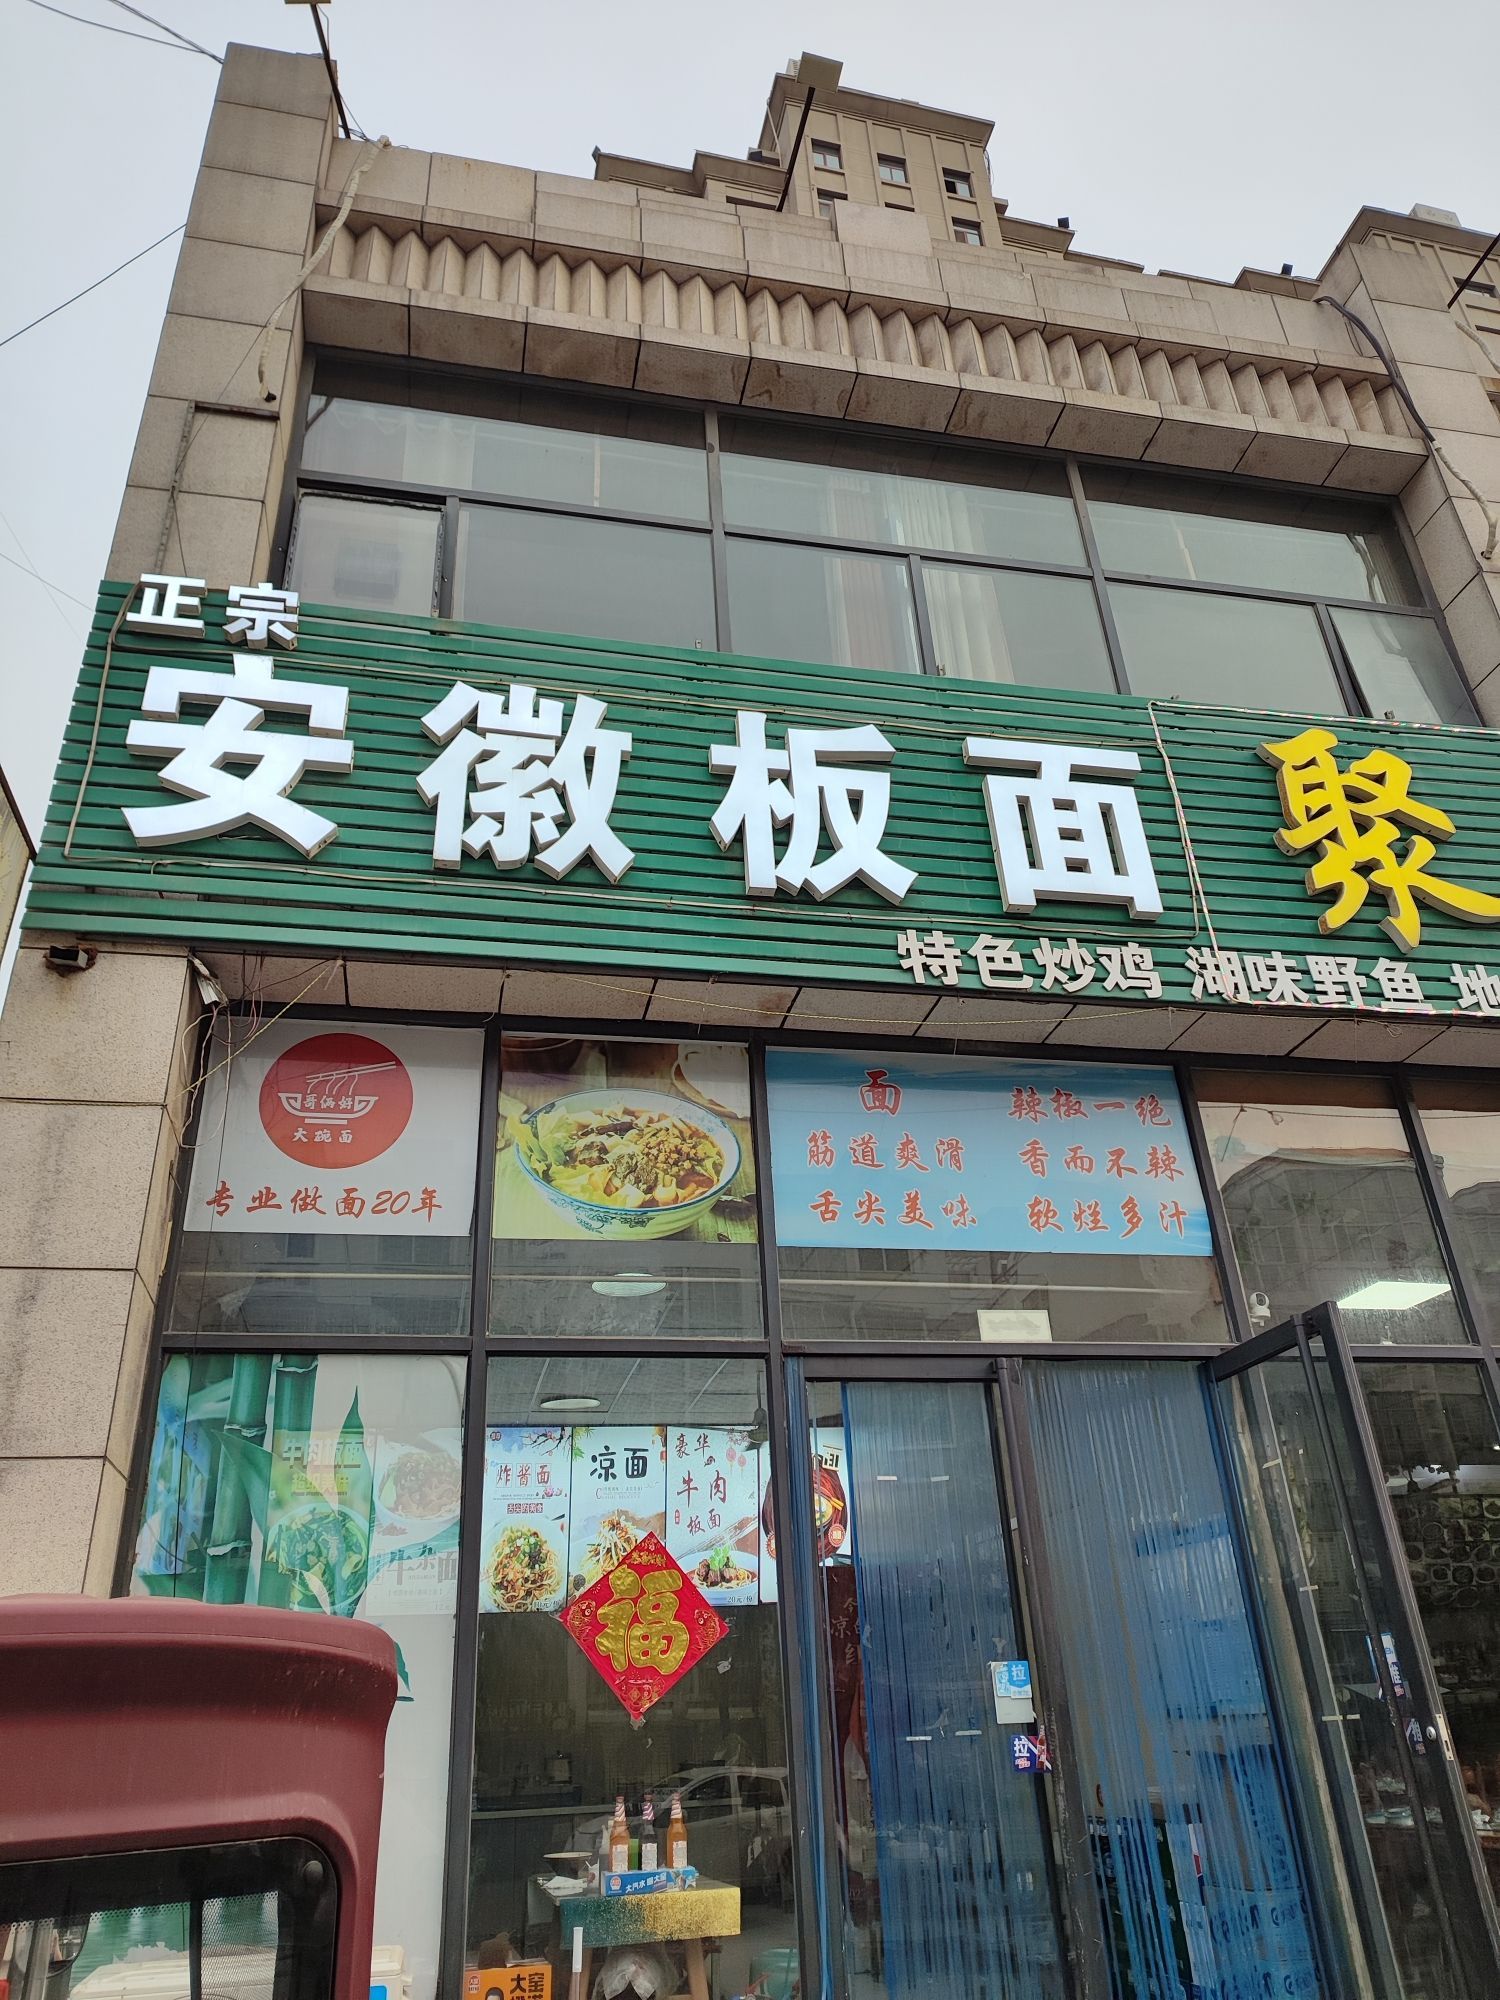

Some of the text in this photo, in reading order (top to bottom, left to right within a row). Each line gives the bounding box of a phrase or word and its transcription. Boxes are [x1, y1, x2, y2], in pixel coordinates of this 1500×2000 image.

[126, 573, 300, 650] 正宗
[121, 654, 1165, 920] 安徽板面
[1257, 728, 1500, 953] 聚
[897, 929, 1164, 999] 特色炒鸡
[1185, 946, 1433, 1014] 湖味野鱼
[303, 1094, 354, 1112] 哥俩好
[859, 1069, 902, 1116] 面
[1008, 1086, 1172, 1128] 辣椒一绝
[292, 1127, 354, 1145] 大碗面
[806, 1130, 965, 1174] 筋道爽滑
[1017, 1137, 1185, 1183] 香而不辣
[205, 1180, 443, 1223] 专业做面20年
[809, 1189, 978, 1231] 舌尖美味
[1026, 1194, 1188, 1239] 软烂多汁
[590, 1445, 649, 1482] 凉面
[675, 1432, 711, 1459] 豪华
[496, 1464, 550, 1487] 炸酱面
[676, 1470, 728, 1508] 牛肉
[687, 1508, 721, 1536] 板面
[594, 1563, 690, 1676] 福
[1011, 1664, 1027, 1681] 拉
[1013, 1737, 1031, 1758] 拉
[509, 1972, 545, 1995] 大窑
